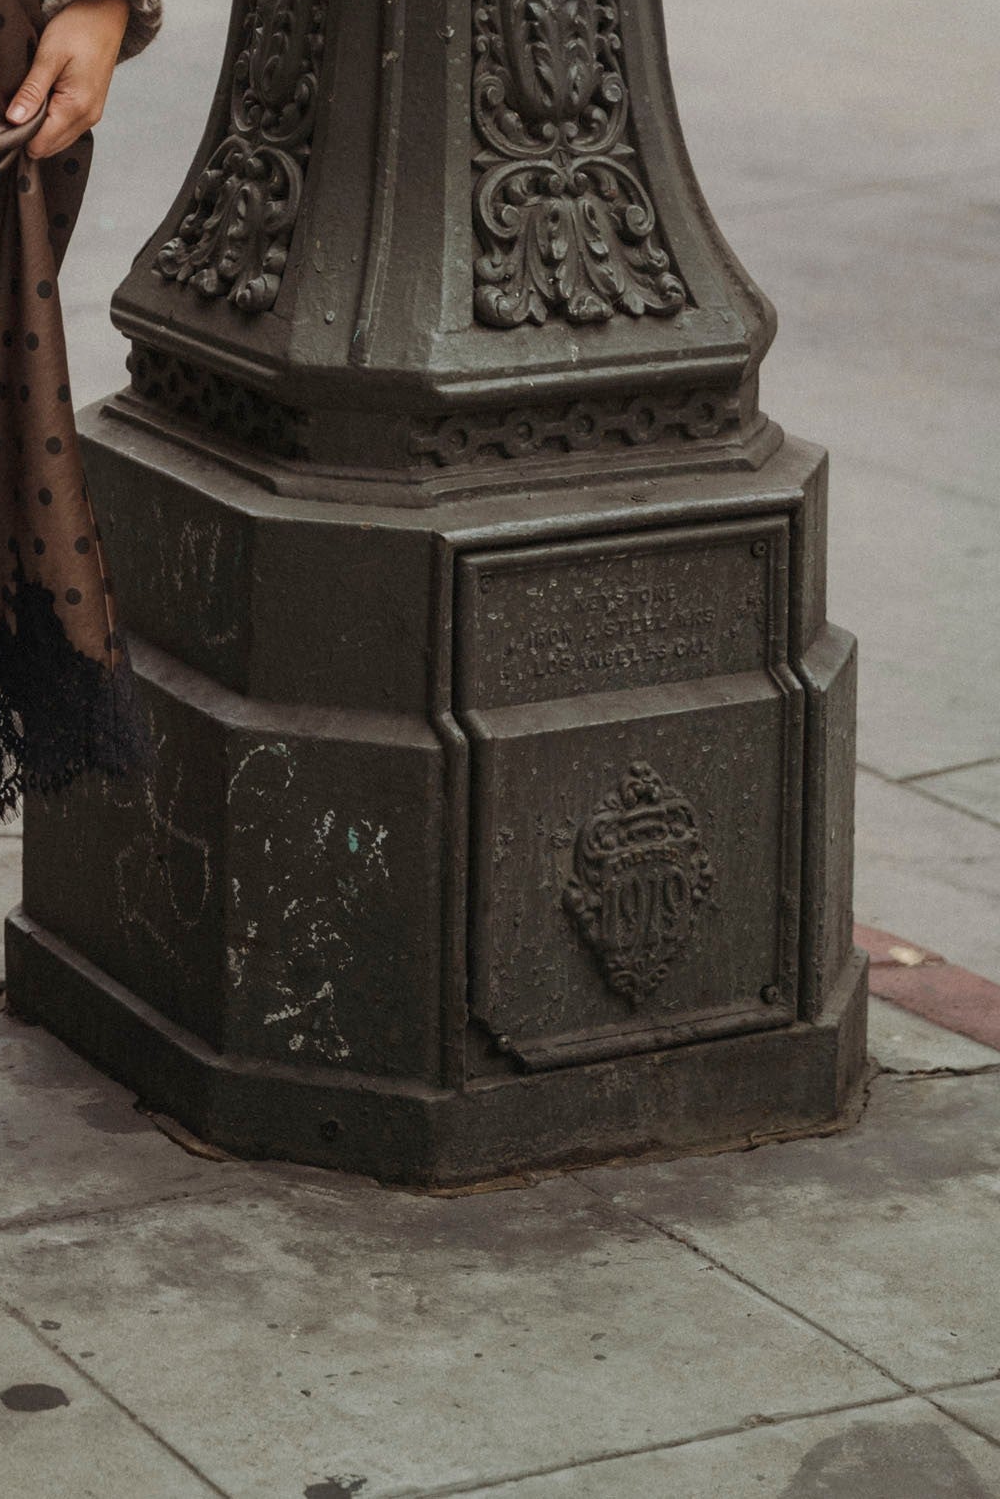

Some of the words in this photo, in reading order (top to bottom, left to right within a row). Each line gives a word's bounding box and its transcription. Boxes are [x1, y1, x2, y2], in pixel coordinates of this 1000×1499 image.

[528, 628, 572, 649] IRON
[603, 614, 668, 638] STEEL
[533, 654, 576, 678] LOS
[579, 644, 667, 671] ANGELES
